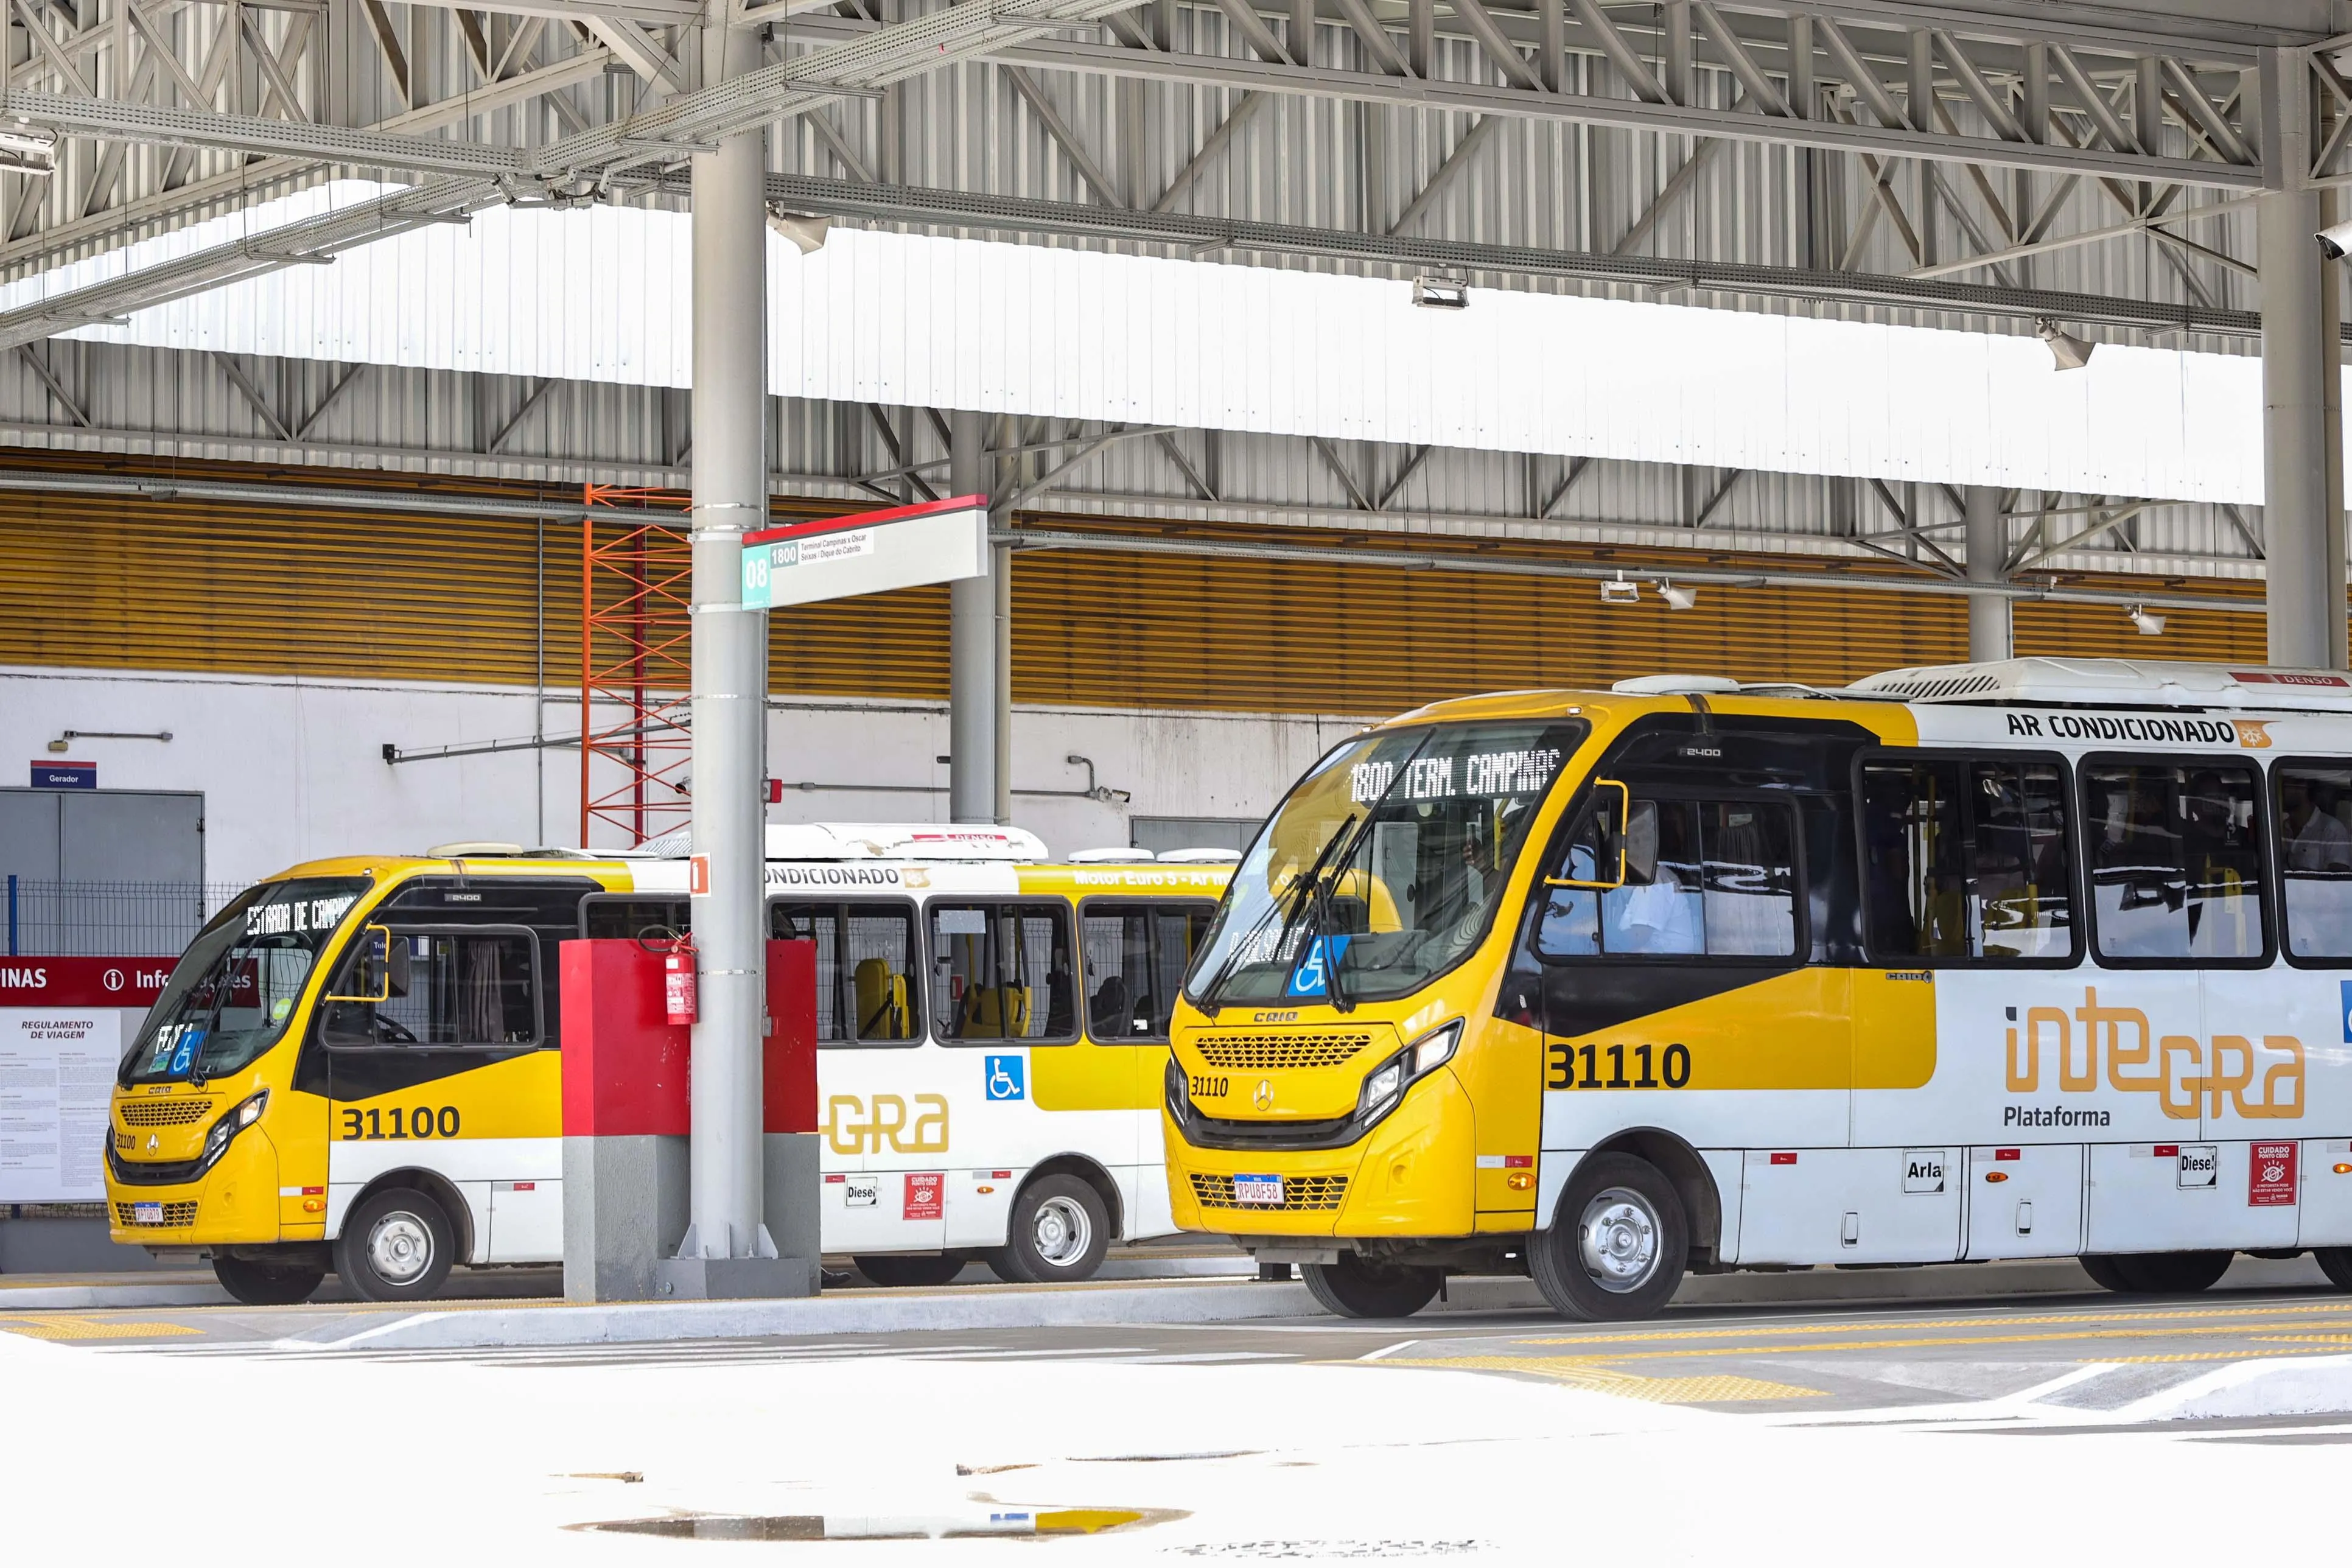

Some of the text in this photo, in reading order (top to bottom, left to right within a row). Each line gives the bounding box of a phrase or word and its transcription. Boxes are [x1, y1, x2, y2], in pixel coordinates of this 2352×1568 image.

[801, 541, 822, 551] Terminal
[822, 537, 846, 547] Campinas
[852, 534, 867, 543] Oscar
[772, 546, 796, 565] 1800
[821, 549, 835, 559] Dique
[843, 545, 861, 554] Cabrito
[746, 558, 768, 589] 08
[2283, 675, 2333, 685] DENSO
[2006, 713, 2235, 743] AR CONDICIONADO
[49, 774, 79, 783] Gerador
[1404, 757, 1456, 799] TERM.
[1073, 870, 1120, 886] Motor
[1125, 870, 1164, 886] Euro
[1166, 872, 1177, 886] 5
[1189, 872, 1209, 886] Ar
[294, 901, 308, 931] DE
[21, 1021, 94, 1029] REGULAMENTO
[30, 1031, 85, 1039] DE VIAGEM
[1548, 1043, 1692, 1089] 31110
[1191, 1076, 1229, 1098] 31110
[342, 1105, 460, 1141] 31100
[2004, 1105, 2111, 1128] Plataforma
[116, 1133, 136, 1150] 31100
[1908, 1161, 1942, 1178] Arla
[1238, 1183, 1278, 1199] RPU8F58
